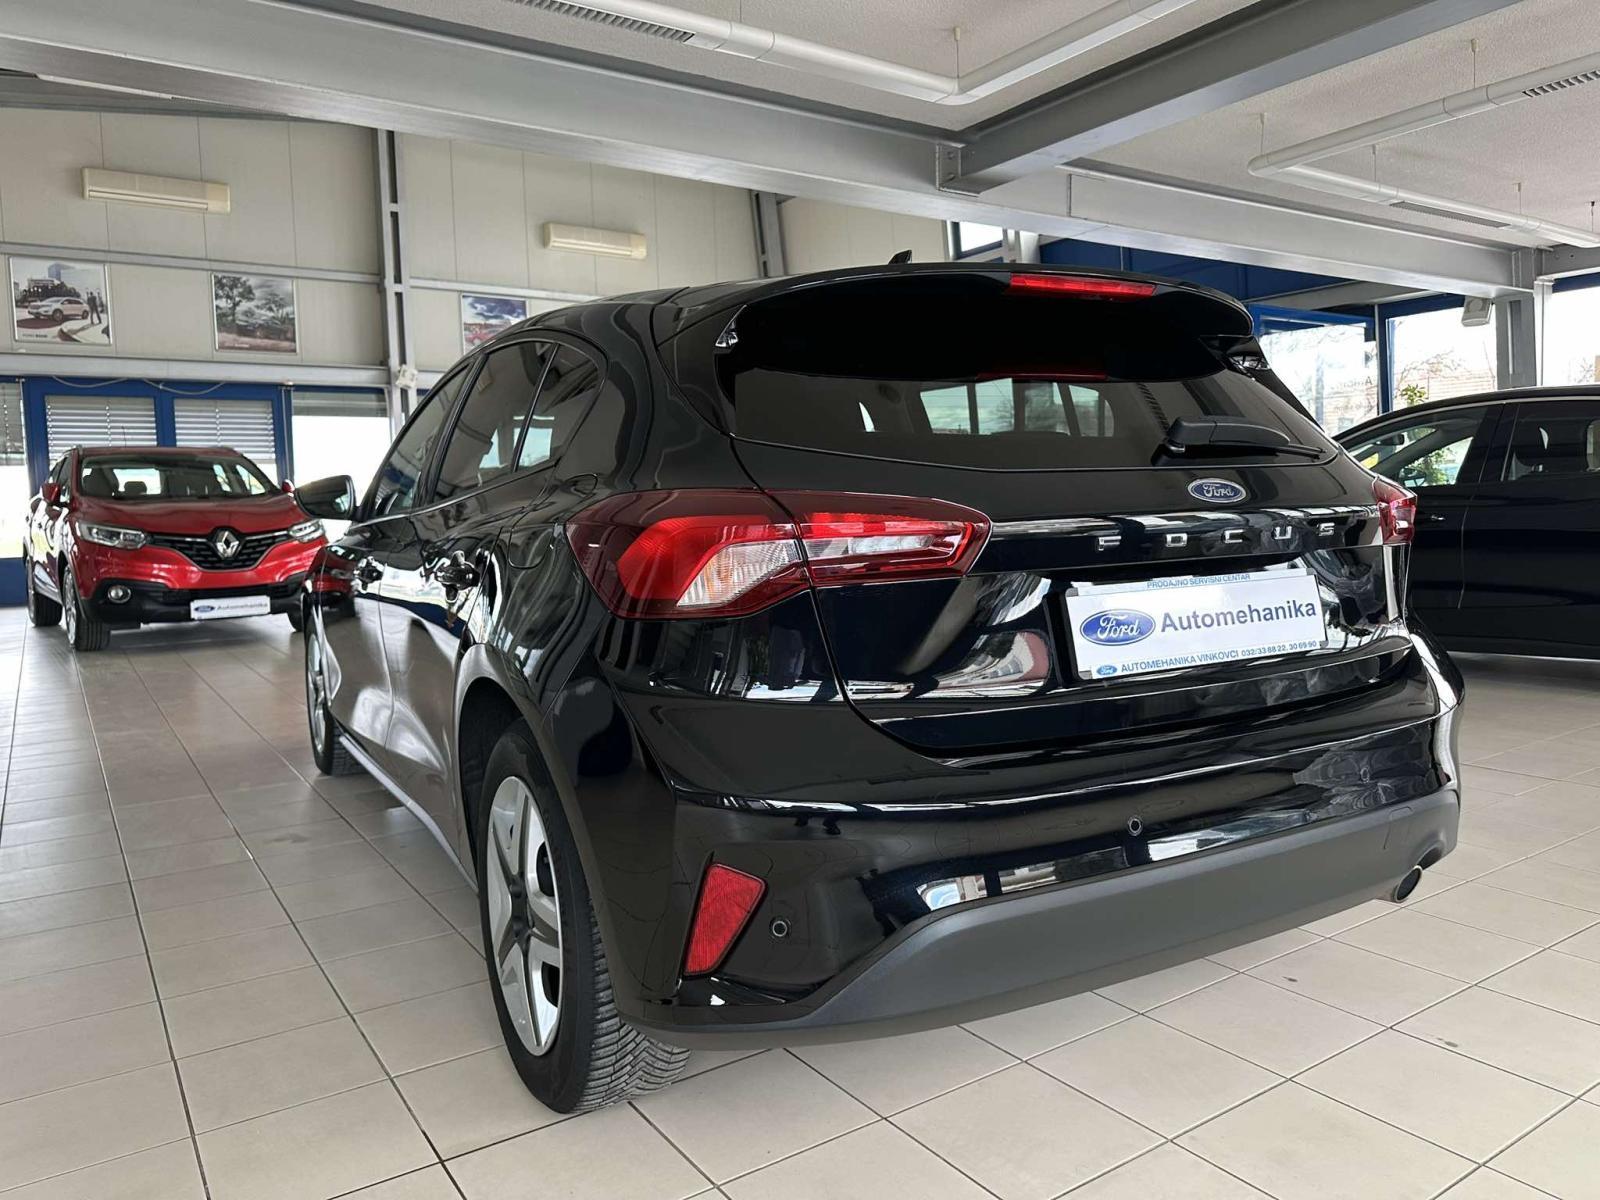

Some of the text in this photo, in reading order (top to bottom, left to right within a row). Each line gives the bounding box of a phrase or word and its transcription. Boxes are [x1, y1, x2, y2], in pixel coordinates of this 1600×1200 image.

[1202, 482, 1235, 498] Ford
[1097, 521, 1336, 552] FOCUS
[1147, 573, 1250, 588] PRODAJNO SERVISNI CENTAR
[1096, 599, 1317, 640] Ford Automehanika
[1121, 656, 1196, 672] AUTOMEHANIKA
[1199, 650, 1239, 662] VINKOVCI
